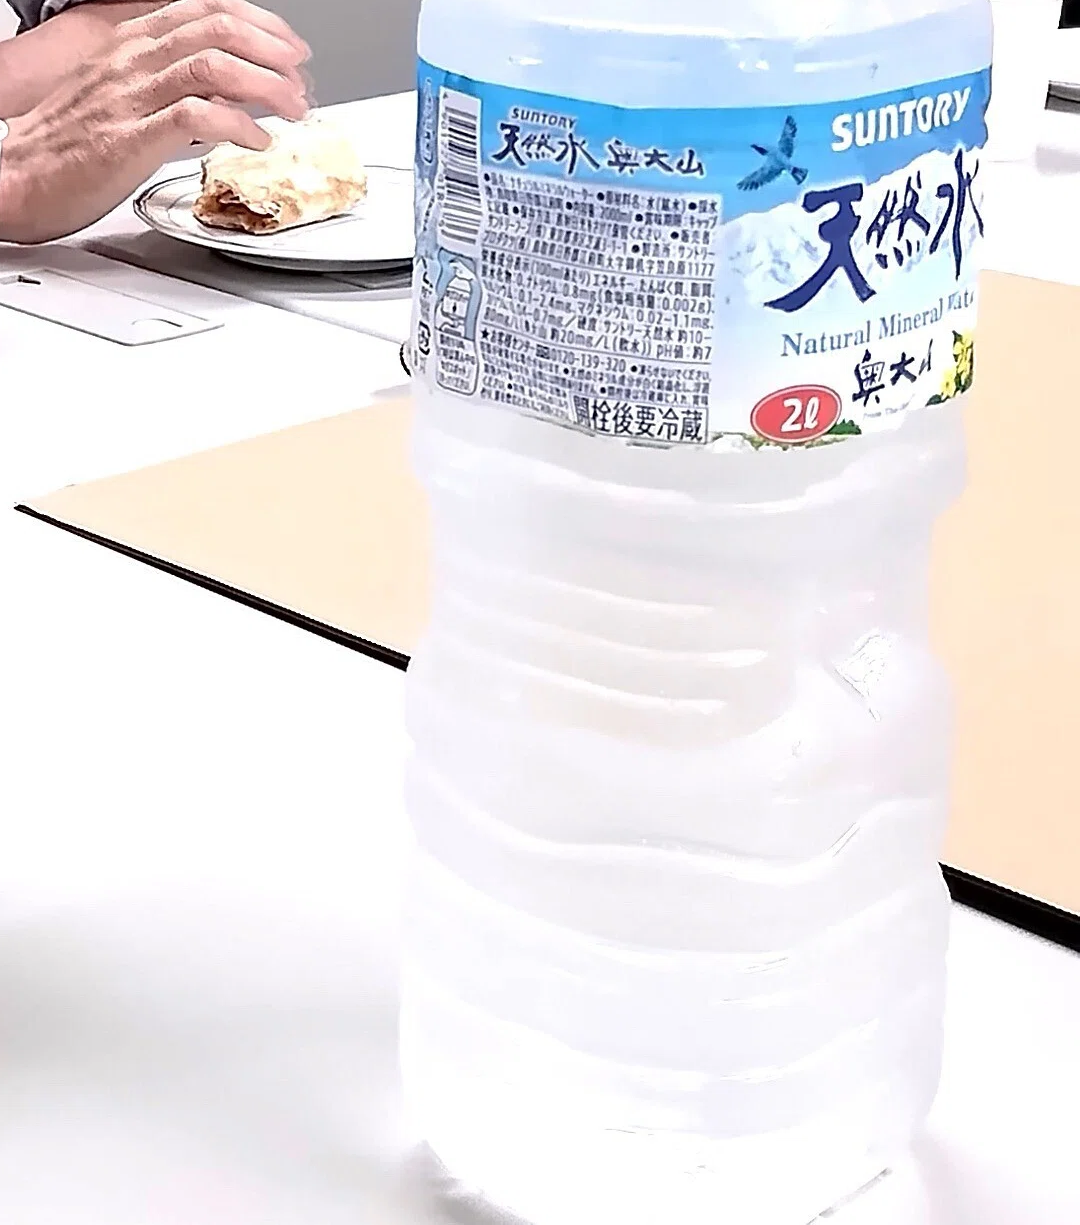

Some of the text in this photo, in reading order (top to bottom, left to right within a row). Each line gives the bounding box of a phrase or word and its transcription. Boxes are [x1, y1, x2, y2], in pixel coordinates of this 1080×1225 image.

[511, 108, 576, 129] SUNTORY
[831, 87, 971, 151] SUNTORY
[492, 123, 600, 174] 天然水
[764, 148, 984, 312] 天然水
[780, 321, 870, 357] Natural
[878, 298, 943, 340] Mineral
[550, 348, 626, 372] 0120-139-320
[574, 395, 703, 441] 開栓後要冷蔵
